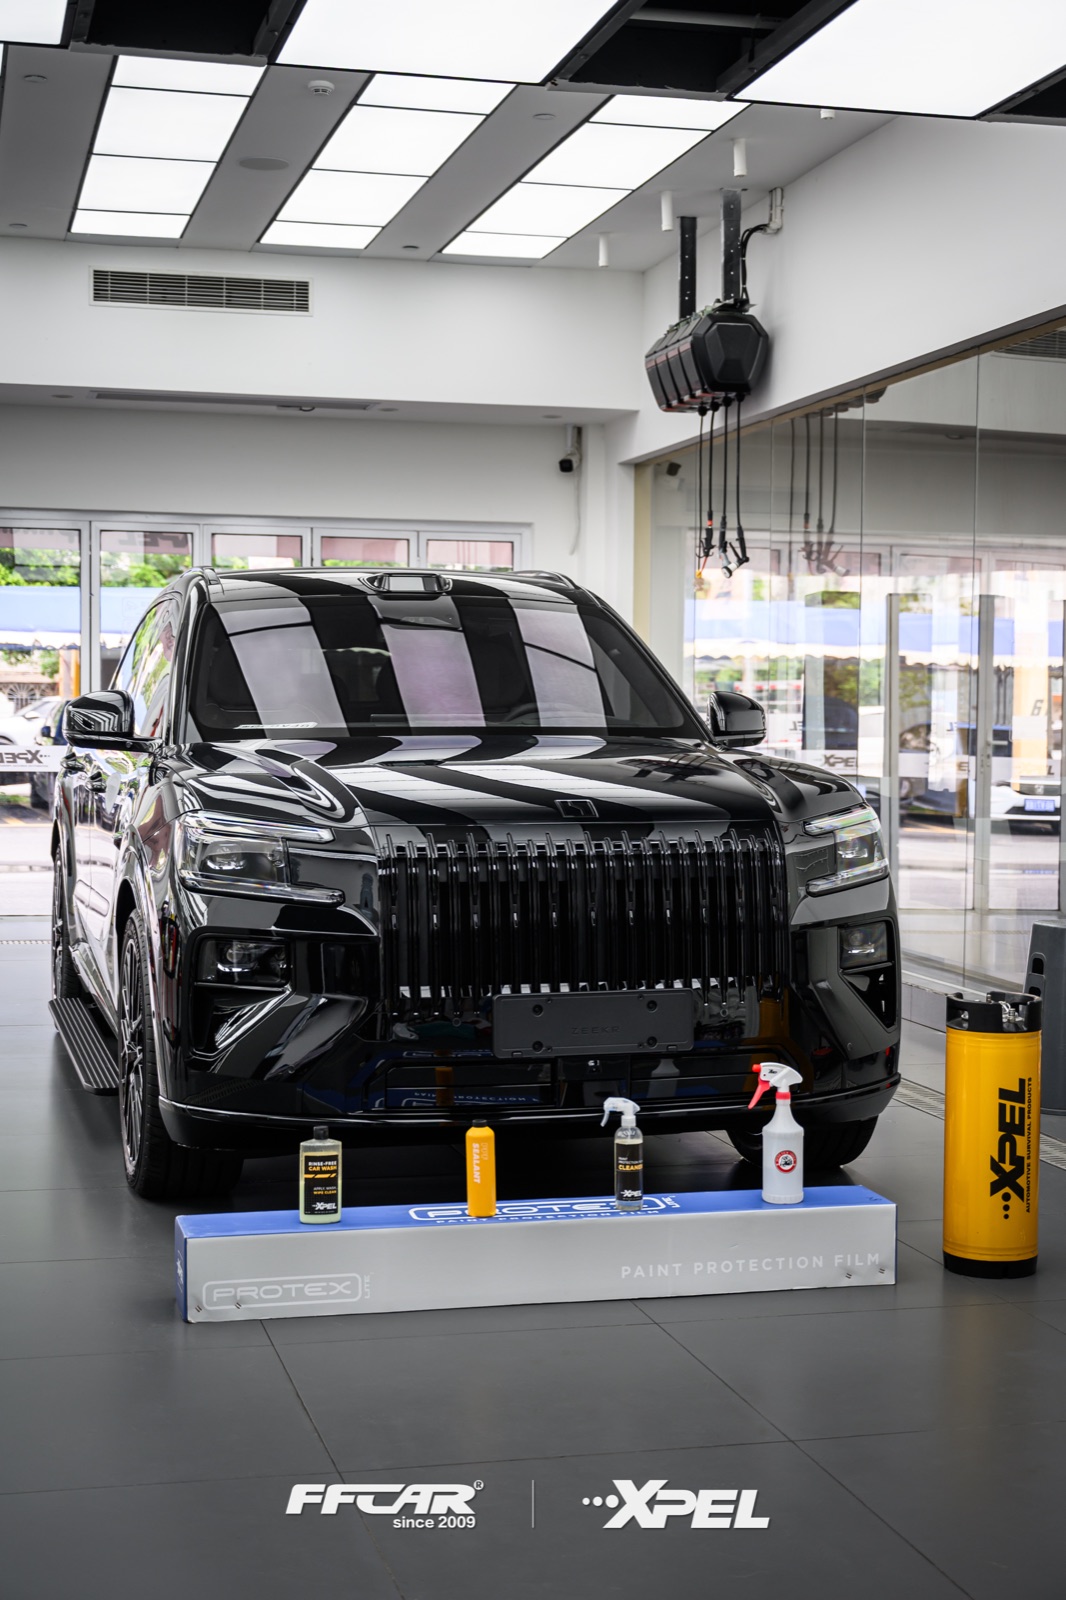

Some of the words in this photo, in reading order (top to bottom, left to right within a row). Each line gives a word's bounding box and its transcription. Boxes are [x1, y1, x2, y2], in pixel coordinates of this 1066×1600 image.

[571, 1026, 620, 1035] ZEEKR
[990, 1077, 1026, 1203] XPEL
[472, 1142, 481, 1184] SEALANT
[315, 1202, 337, 1210] XPEL
[427, 1202, 648, 1217] POTE
[621, 1263, 682, 1279] PAINT
[694, 1255, 824, 1275] PROTECTION
[835, 1252, 880, 1267] FILM
[213, 1281, 351, 1302] PROTEX
